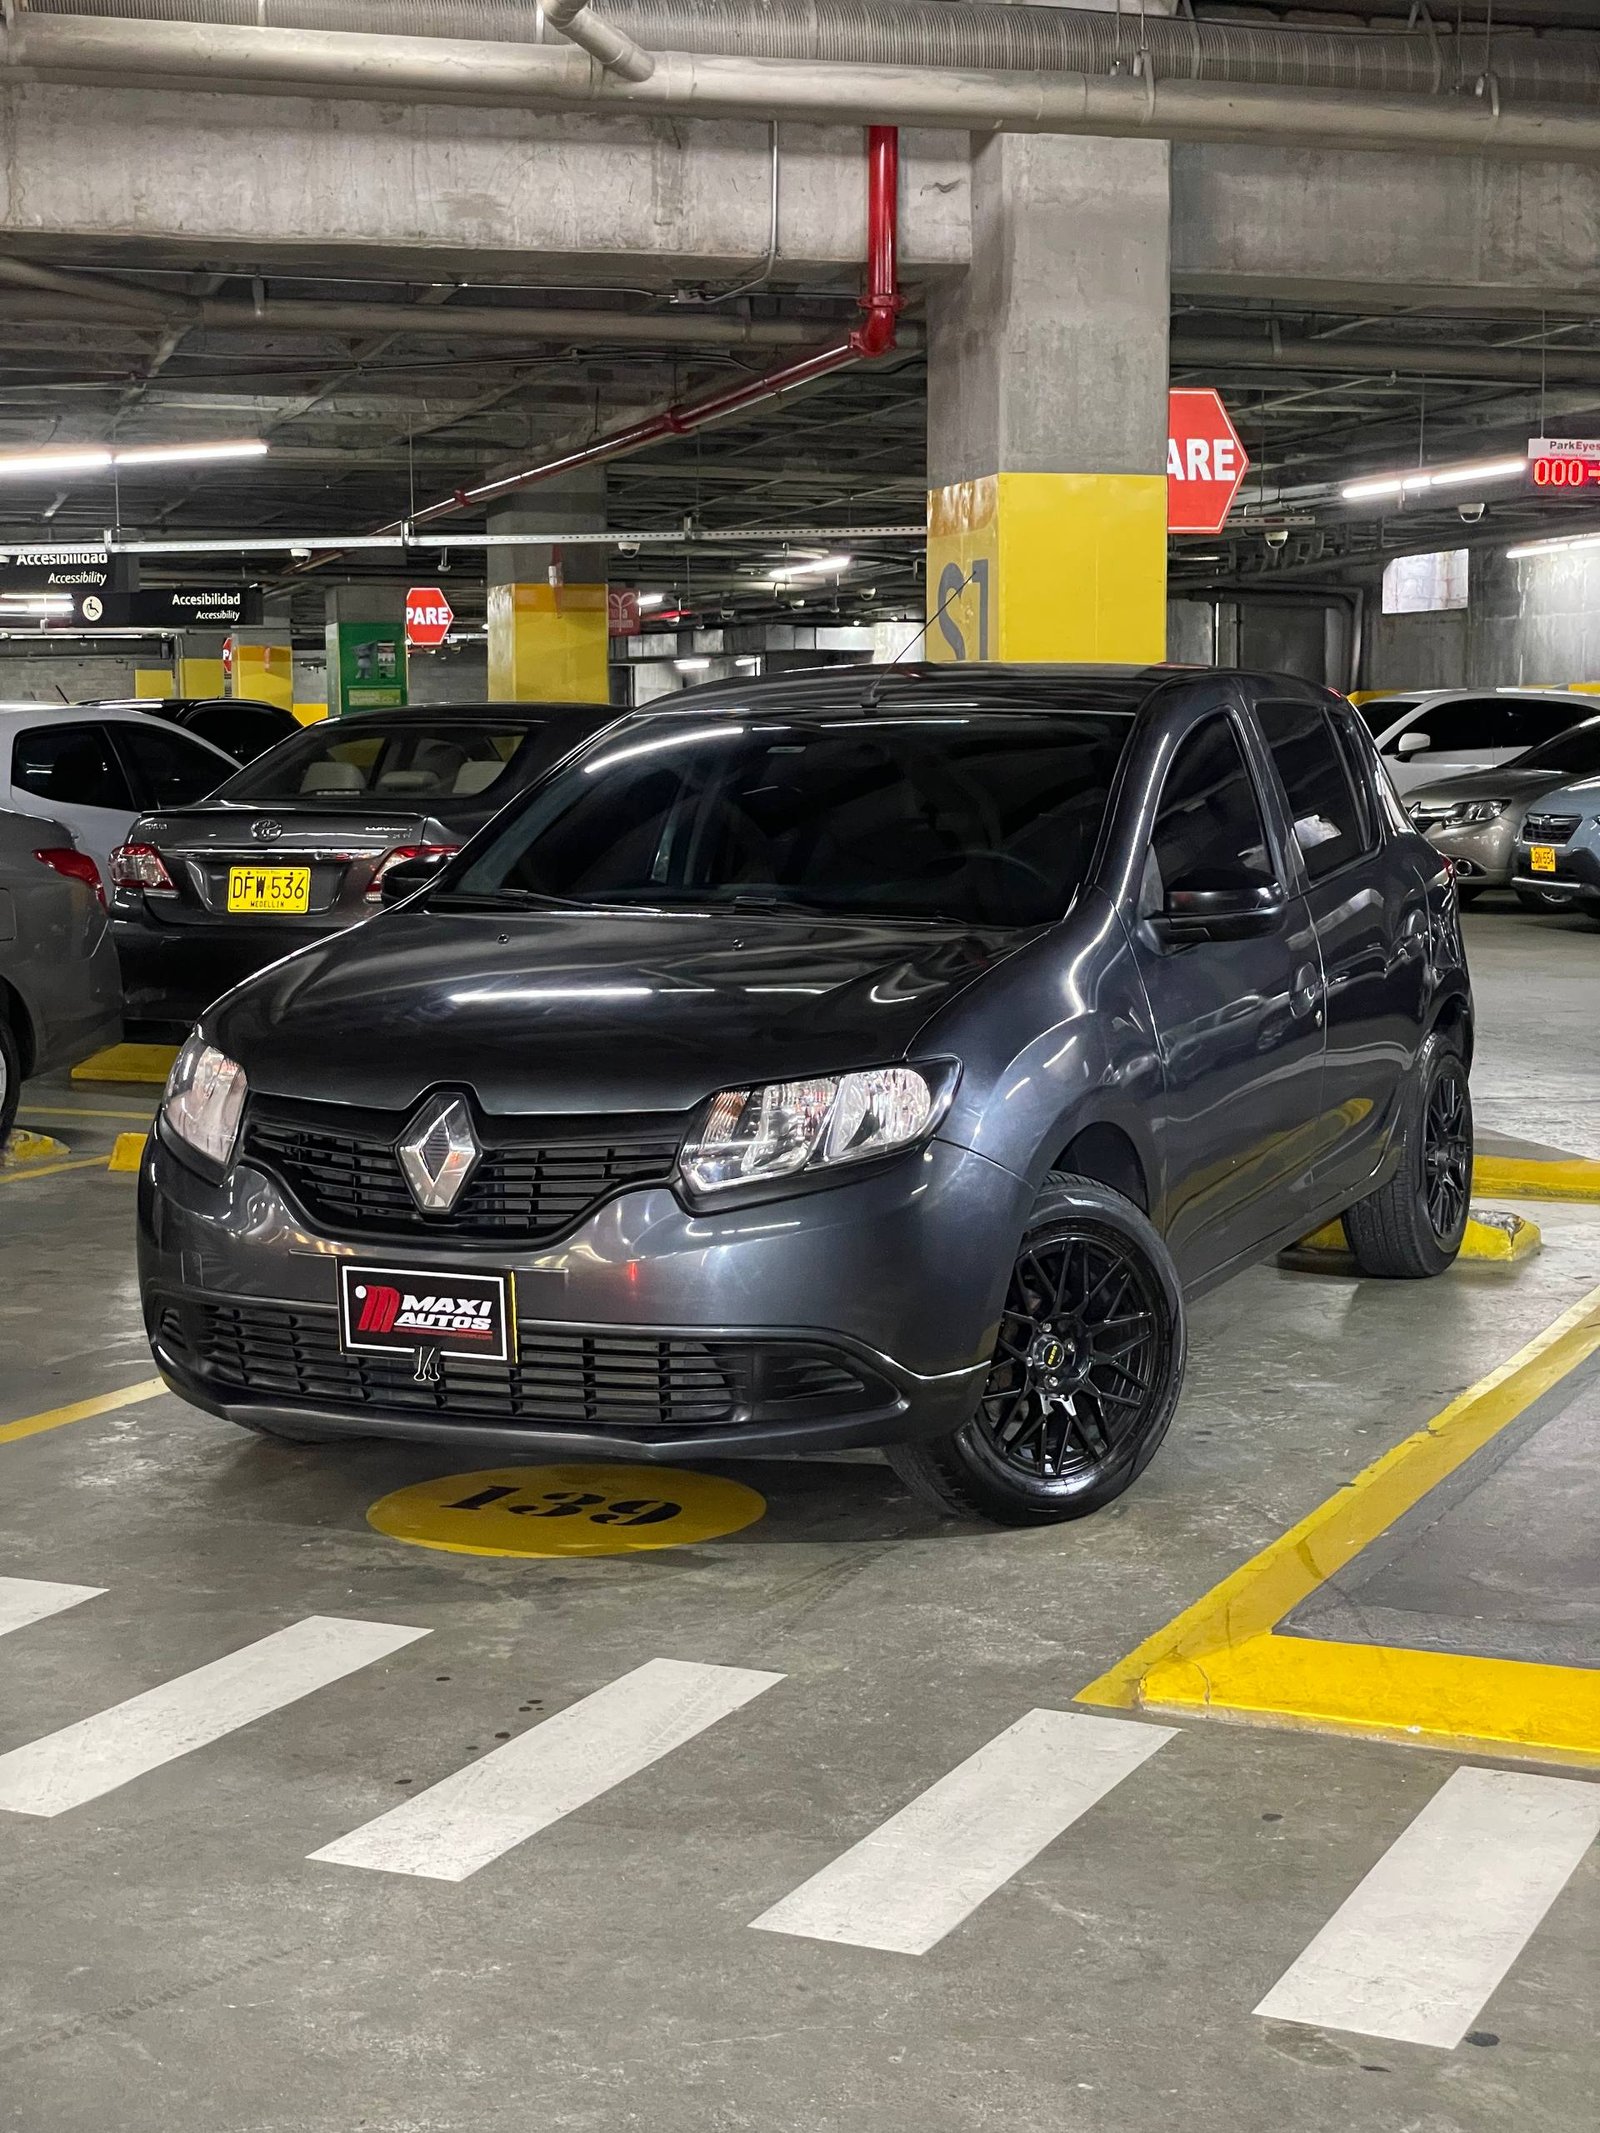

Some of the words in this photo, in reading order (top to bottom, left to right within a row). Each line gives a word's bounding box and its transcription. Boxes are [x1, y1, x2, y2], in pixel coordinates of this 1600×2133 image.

[1166, 438, 1237, 482] ARE
[1534, 459, 1584, 486] 000
[47, 572, 108, 586] Accessibility
[171, 593, 241, 606] Accesibilidad
[195, 610, 241, 622] Accessibility
[406, 606, 450, 626] PARE
[250, 900, 285, 909] MEDELLIN
[401, 1294, 493, 1317] MAXI
[396, 1311, 493, 1331] AUTOS
[439, 1485, 682, 1526] 139
